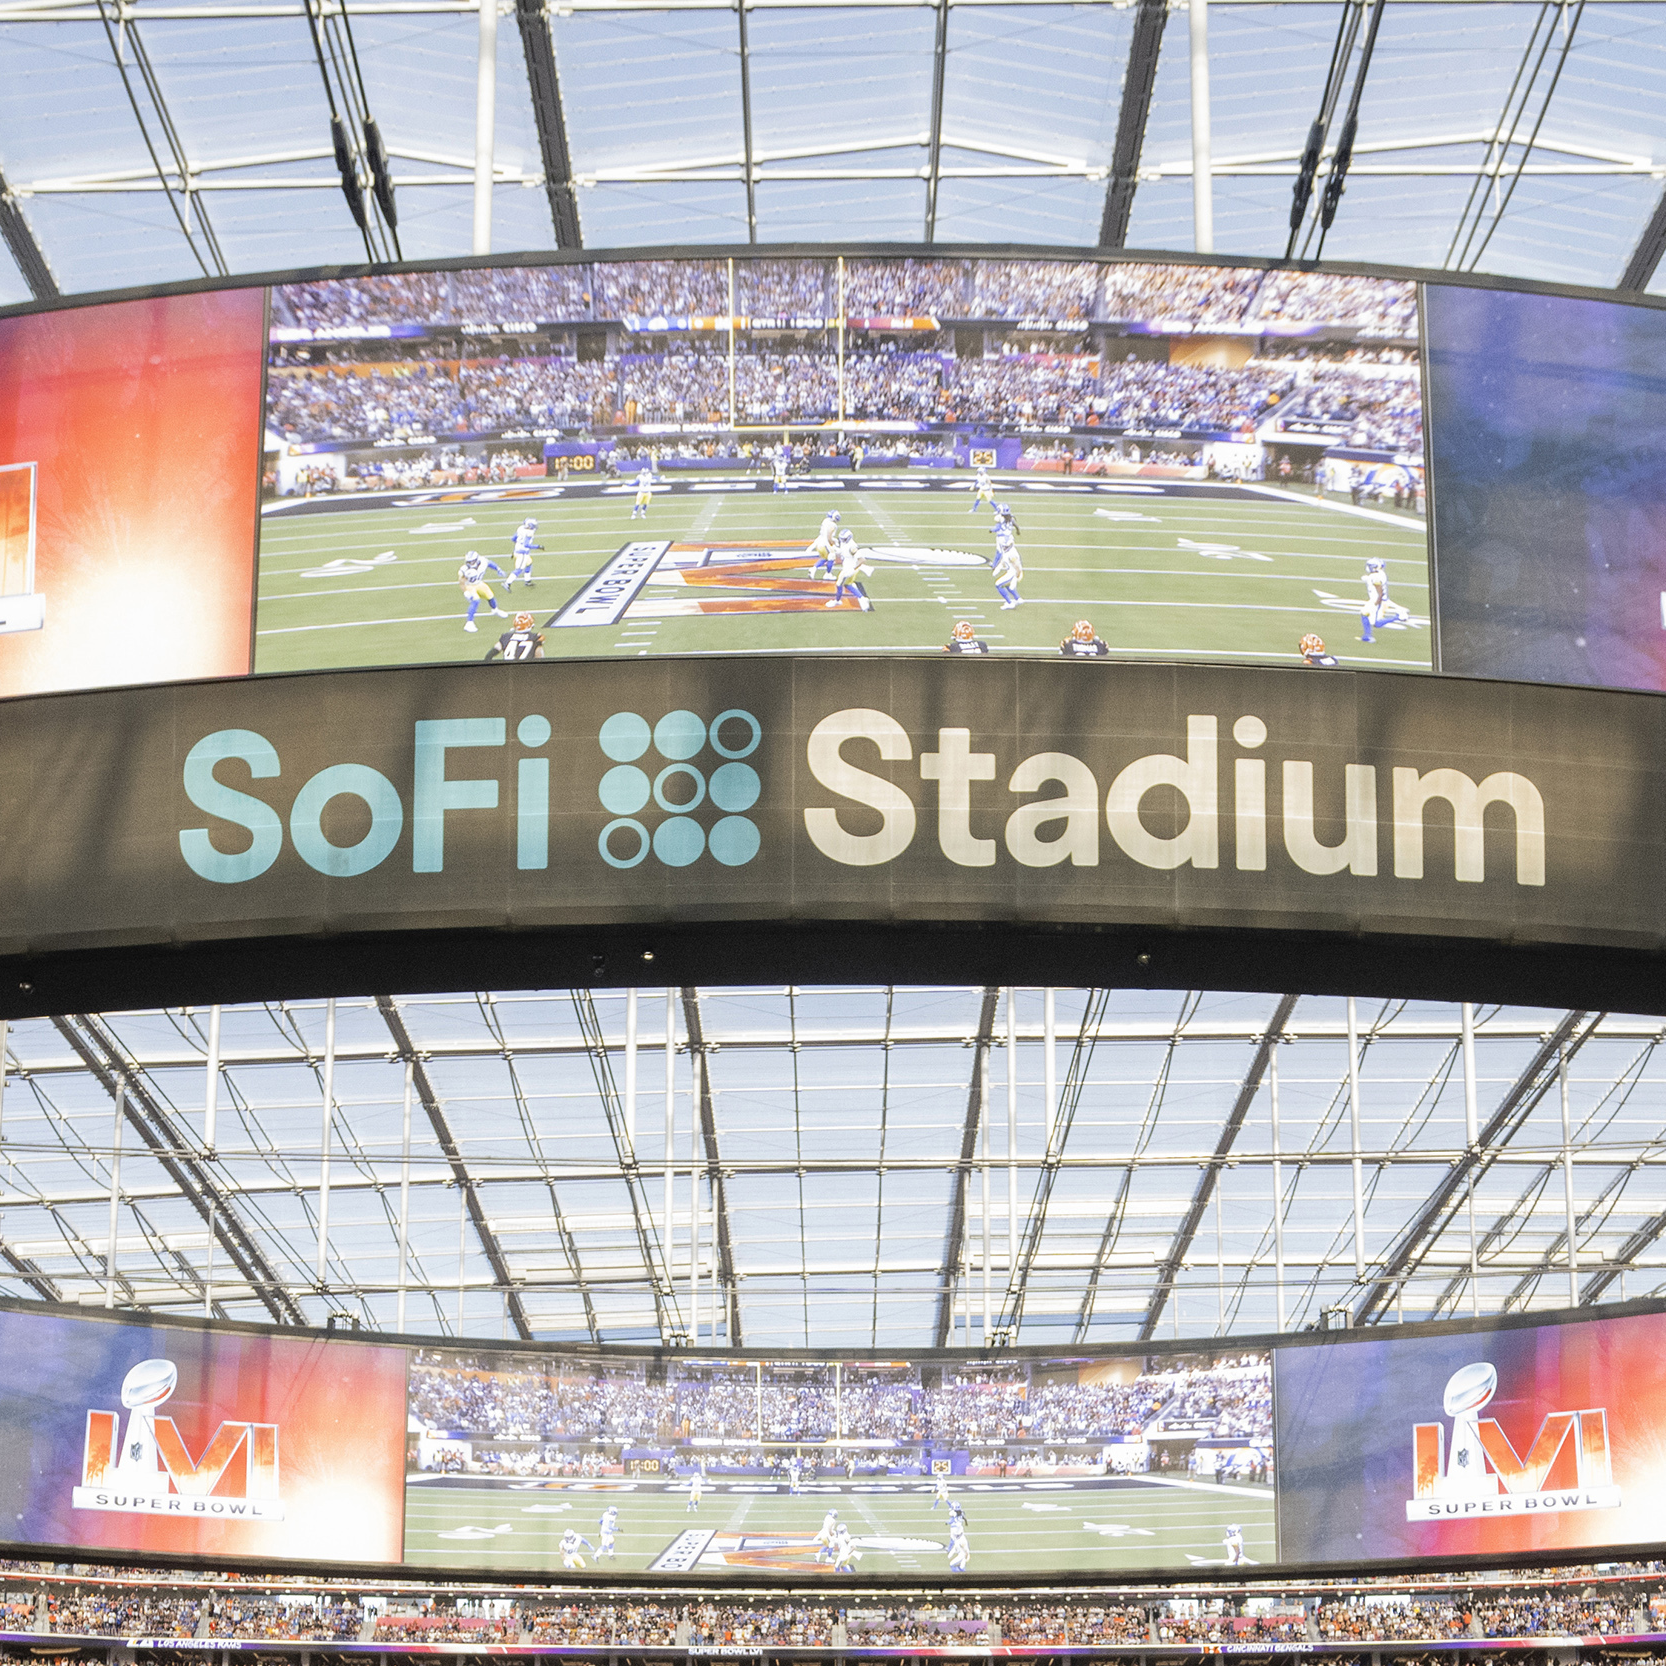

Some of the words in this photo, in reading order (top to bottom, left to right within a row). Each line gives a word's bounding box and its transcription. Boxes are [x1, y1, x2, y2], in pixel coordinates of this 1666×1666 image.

[179, 713, 550, 884] SoFi
[803, 708, 1546, 886] Stadium
[95, 1494, 181, 1511] SUPER
[193, 1500, 263, 1516] BOWL
[1429, 1499, 1514, 1516] SUPER
[1524, 1495, 1598, 1510] BOWL
